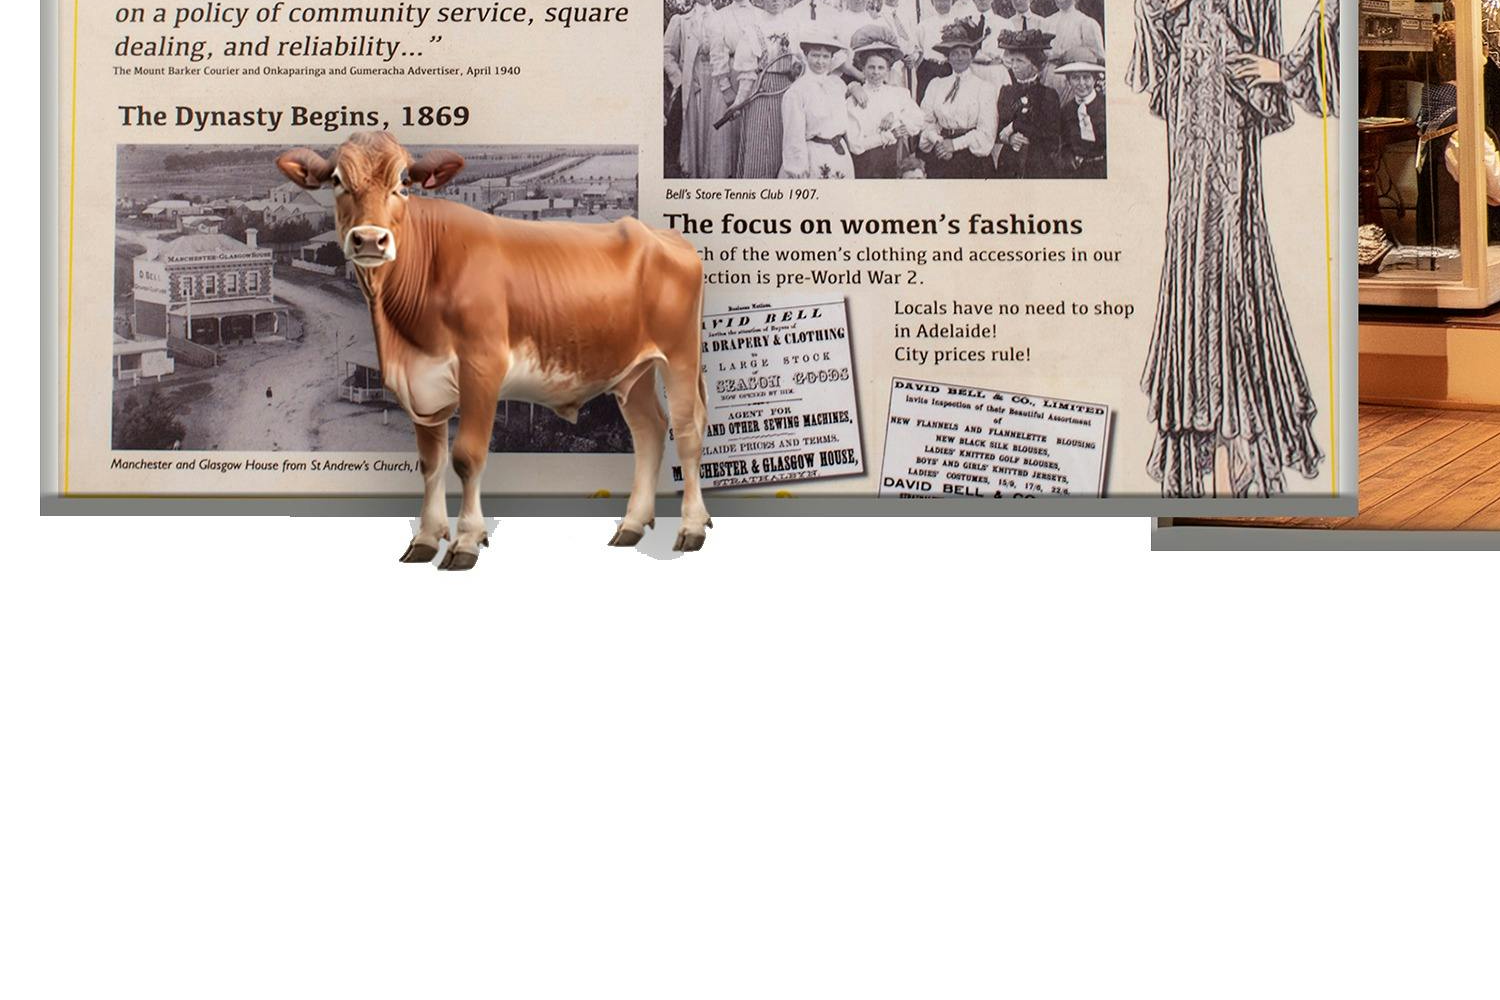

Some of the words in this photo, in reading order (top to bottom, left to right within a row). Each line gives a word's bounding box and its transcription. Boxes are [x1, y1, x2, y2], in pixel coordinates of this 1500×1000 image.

[116, 8, 144, 22] on
[153, 8, 165, 22] a
[173, 2, 249, 28] policy
[257, 2, 284, 22] of
[289, 2, 430, 28] community
[437, 2, 533, 25] service,
[545, 7, 628, 28] square
[115, 36, 212, 62] dealing,
[224, 36, 268, 58] and
[113, 67, 131, 75] The
[134, 67, 164, 75] Mount
[168, 66, 200, 75] Barker
[204, 67, 239, 75] Courier
[242, 67, 260, 75] and
[263, 66, 326, 77] Onkaparinga
[329, 67, 346, 75] and
[350, 66, 404, 75] Gumeracha
[408, 66, 463, 76] Advertiser,
[467, 66, 491, 77] April
[496, 66, 520, 75] 1940
[118, 106, 166, 125] The
[176, 107, 283, 132] Dynasty
[291, 106, 388, 134] Begins,
[403, 106, 469, 126] 1869
[666, 189, 691, 199] Bell's
[696, 189, 722, 200] Store
[725, 189, 756, 199] Tennis
[760, 189, 783, 199] Club
[790, 189, 818, 200] 1907.
[663, 213, 713, 234] The
[721, 213, 791, 234] focus
[800, 219, 832, 234] on
[840, 214, 960, 234] women's
[969, 214, 1082, 234] fashions
[720, 247, 738, 261] of
[743, 247, 769, 261] the
[775, 247, 851, 261] women's
[857, 247, 927, 265] clothing
[933, 247, 963, 261] and
[969, 248, 1065, 261] accessories
[1072, 248, 1087, 261] in
[1094, 251, 1121, 261] our
[757, 270, 770, 284] is
[777, 270, 861, 288] pre-World
[868, 271, 901, 284] War
[908, 270, 923, 284] 2.
[895, 381, 940, 393] DAVID
[948, 387, 985, 398] BELL
[993, 393, 1004, 401] &
[1043, 399, 1104, 415] LIMITED
[707, 423, 725, 437] AND
[729, 420, 760, 434] OTHER
[764, 416, 799, 431] SEWING
[111, 459, 172, 469] Manchester
[176, 459, 196, 470] and
[199, 459, 242, 473] Glasgow
[245, 460, 278, 470] House
[282, 460, 306, 472] from
[311, 460, 321, 470] St
[323, 460, 369, 471] Andrew's
[373, 459, 413, 473] Church,
